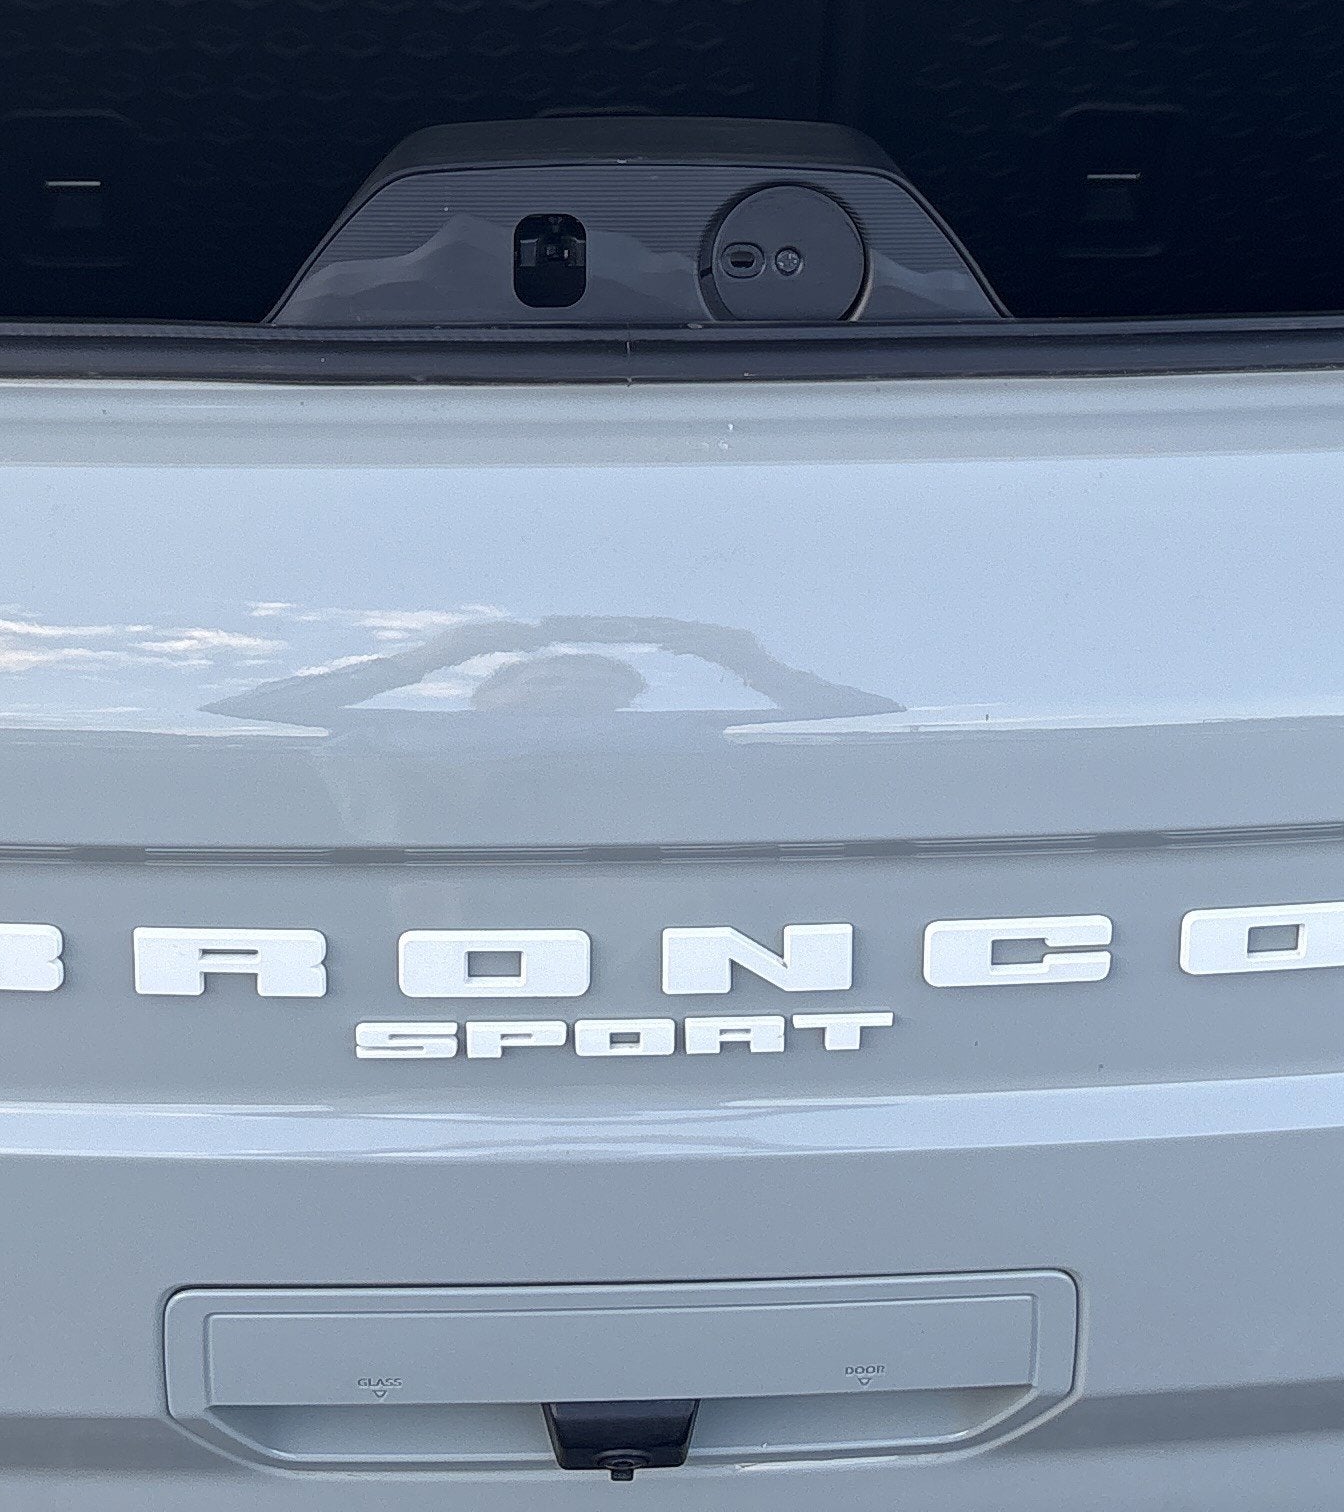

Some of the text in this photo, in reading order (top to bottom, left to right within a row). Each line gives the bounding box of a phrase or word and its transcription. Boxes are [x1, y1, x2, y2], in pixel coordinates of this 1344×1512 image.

[355, 1011, 895, 1059] SPORT
[845, 1365, 886, 1376] DOOR
[357, 1377, 404, 1388] GLASS
